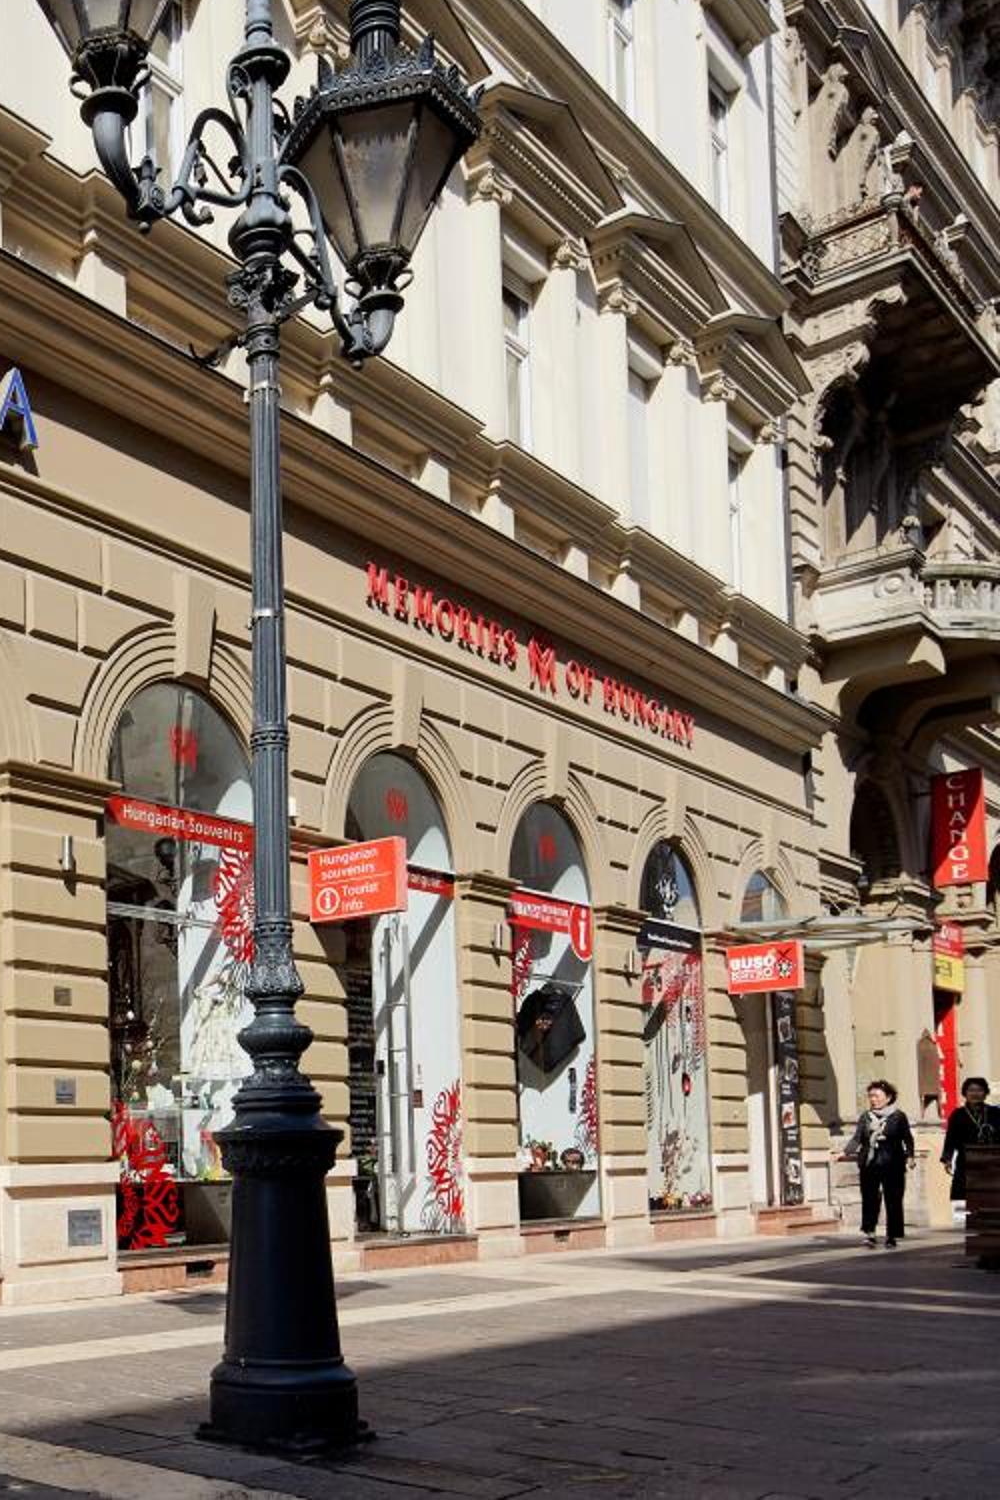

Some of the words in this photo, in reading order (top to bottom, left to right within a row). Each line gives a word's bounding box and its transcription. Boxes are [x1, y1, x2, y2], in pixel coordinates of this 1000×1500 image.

[366, 561, 518, 670] MEMORIES
[565, 660, 595, 704] OF
[603, 675, 695, 749] HUNGARY
[123, 803, 185, 830] Hungarian
[189, 817, 243, 843] Souvenirs
[319, 847, 378, 867] Hungarian
[320, 863, 377, 881] souvenirs
[341, 881, 379, 897] Tourist
